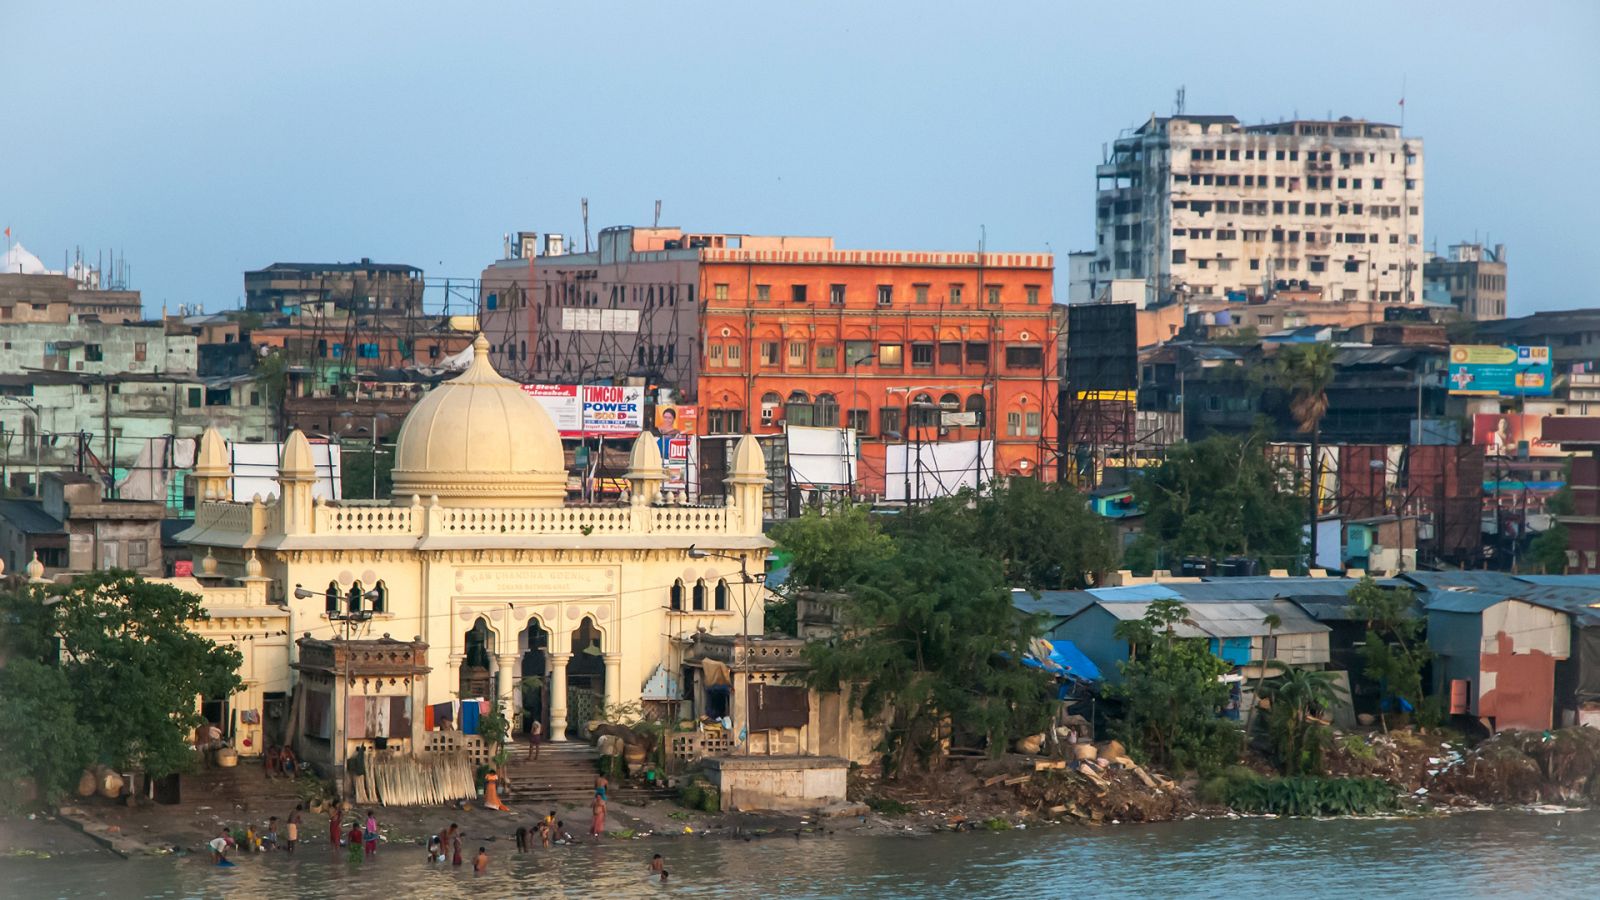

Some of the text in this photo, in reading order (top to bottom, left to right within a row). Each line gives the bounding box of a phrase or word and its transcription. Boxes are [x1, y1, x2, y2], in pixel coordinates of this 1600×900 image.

[1531, 348, 1547, 358] LIC
[584, 387, 624, 402] TIMCON
[584, 403, 637, 412] POWER
